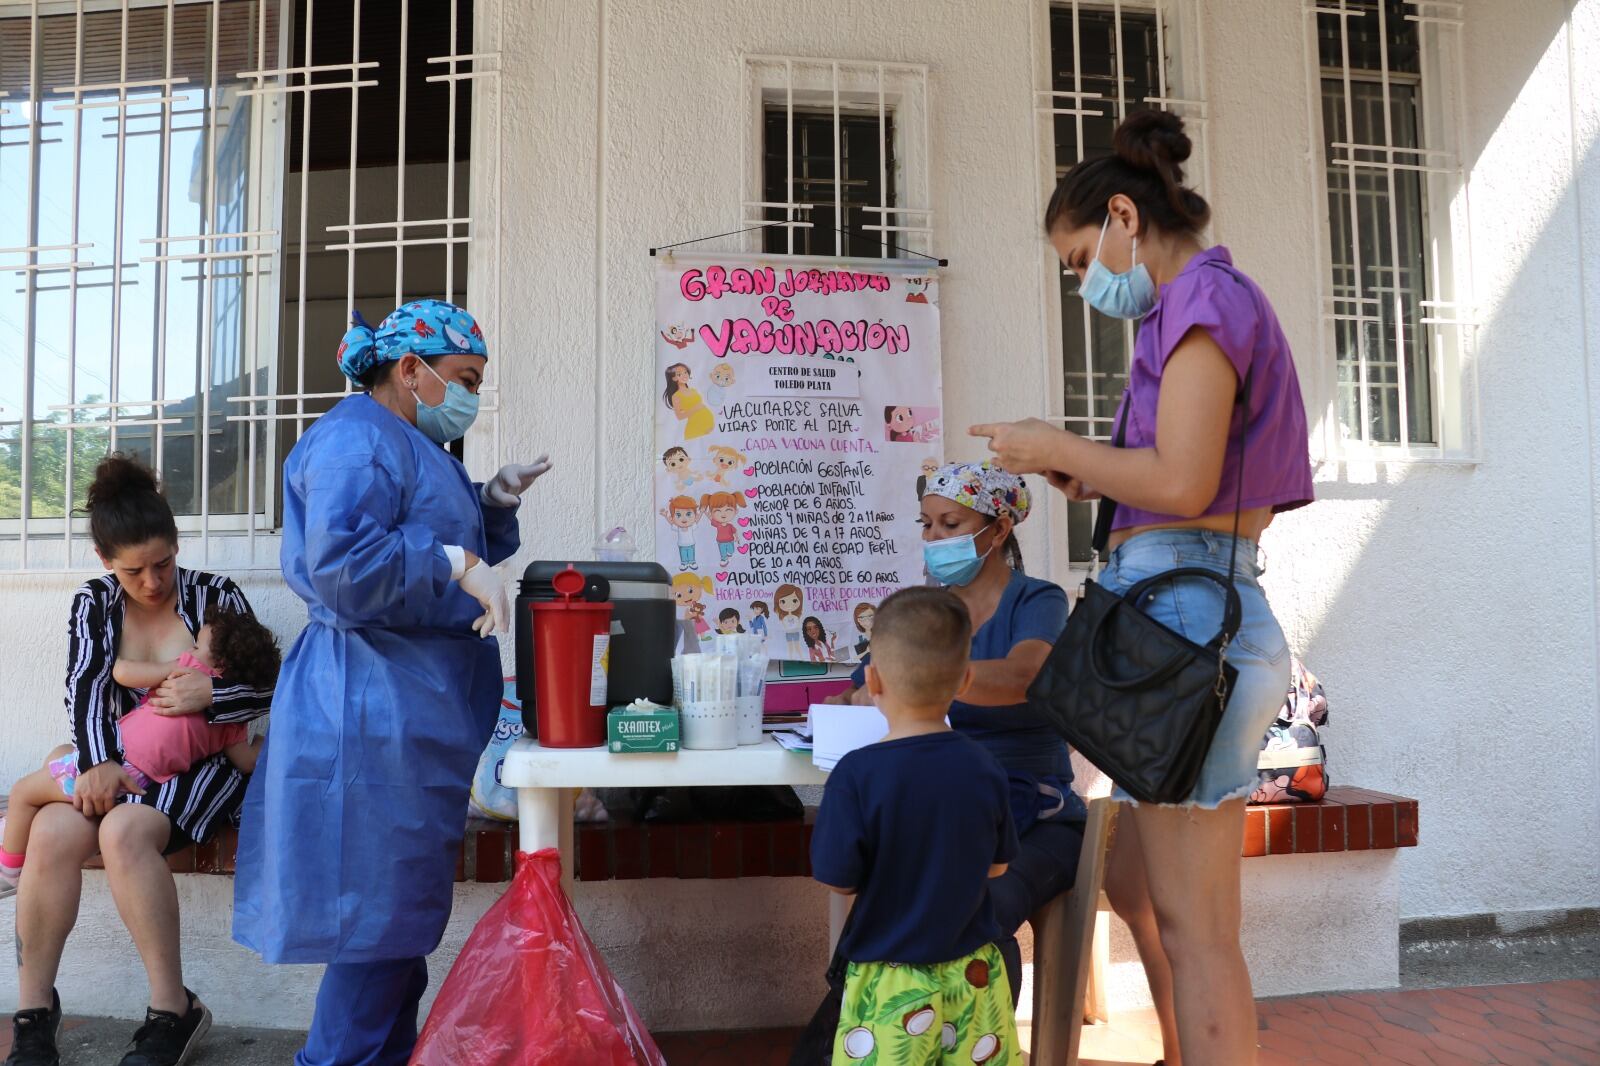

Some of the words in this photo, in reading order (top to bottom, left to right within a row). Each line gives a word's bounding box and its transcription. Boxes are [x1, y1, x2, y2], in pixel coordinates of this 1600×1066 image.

[680, 265, 776, 301] GRAN
[778, 269, 891, 298] JORNADA
[761, 296, 795, 322] DE
[699, 318, 910, 358] VACUNACIÓN
[769, 366, 799, 376] CENTRO
[801, 367, 811, 377] DE
[813, 368, 836, 378] SALUD
[774, 380, 805, 389] TOLEDO
[807, 381, 832, 391] PLATA
[723, 400, 812, 420] VACUNARSE
[820, 401, 863, 418] SALVA
[718, 419, 758, 433] VIDAS
[766, 418, 797, 432] PONTE
[804, 418, 819, 432] AL
[781, 437, 826, 451] VACUNA
[754, 458, 813, 478] POBLACIÓN
[757, 480, 816, 499] POBLACIÓN
[819, 480, 865, 498] INFANTIL
[754, 497, 789, 512] MENOR
[794, 499, 809, 509] DE
[813, 497, 822, 509] 6
[749, 512, 783, 527] NIÑOS
[796, 511, 830, 525] NIÑAS
[832, 511, 845, 524] de
[848, 511, 855, 524] 2
[857, 513, 864, 523] A
[865, 510, 875, 522] 11
[875, 511, 895, 522] AÑOS
[752, 527, 788, 541] NIÑAS
[793, 527, 808, 540] DE
[811, 525, 820, 539] 9
[824, 529, 831, 538] A
[834, 527, 845, 539] 17
[813, 542, 829, 554] EN
[832, 541, 864, 555] EDAD
[750, 557, 766, 569] DE
[771, 557, 783, 568] 10
[786, 559, 793, 568] A
[795, 556, 811, 569] 49
[726, 571, 779, 586] ADULTOS
[783, 570, 836, 586] MAYORES
[839, 571, 854, 583] DE
[857, 571, 872, 583] 60
[804, 586, 836, 600] TRAER
[840, 586, 892, 599] DOCUMENTO
[812, 599, 849, 612] CARNET
[617, 720, 661, 734] EXAMTEX
